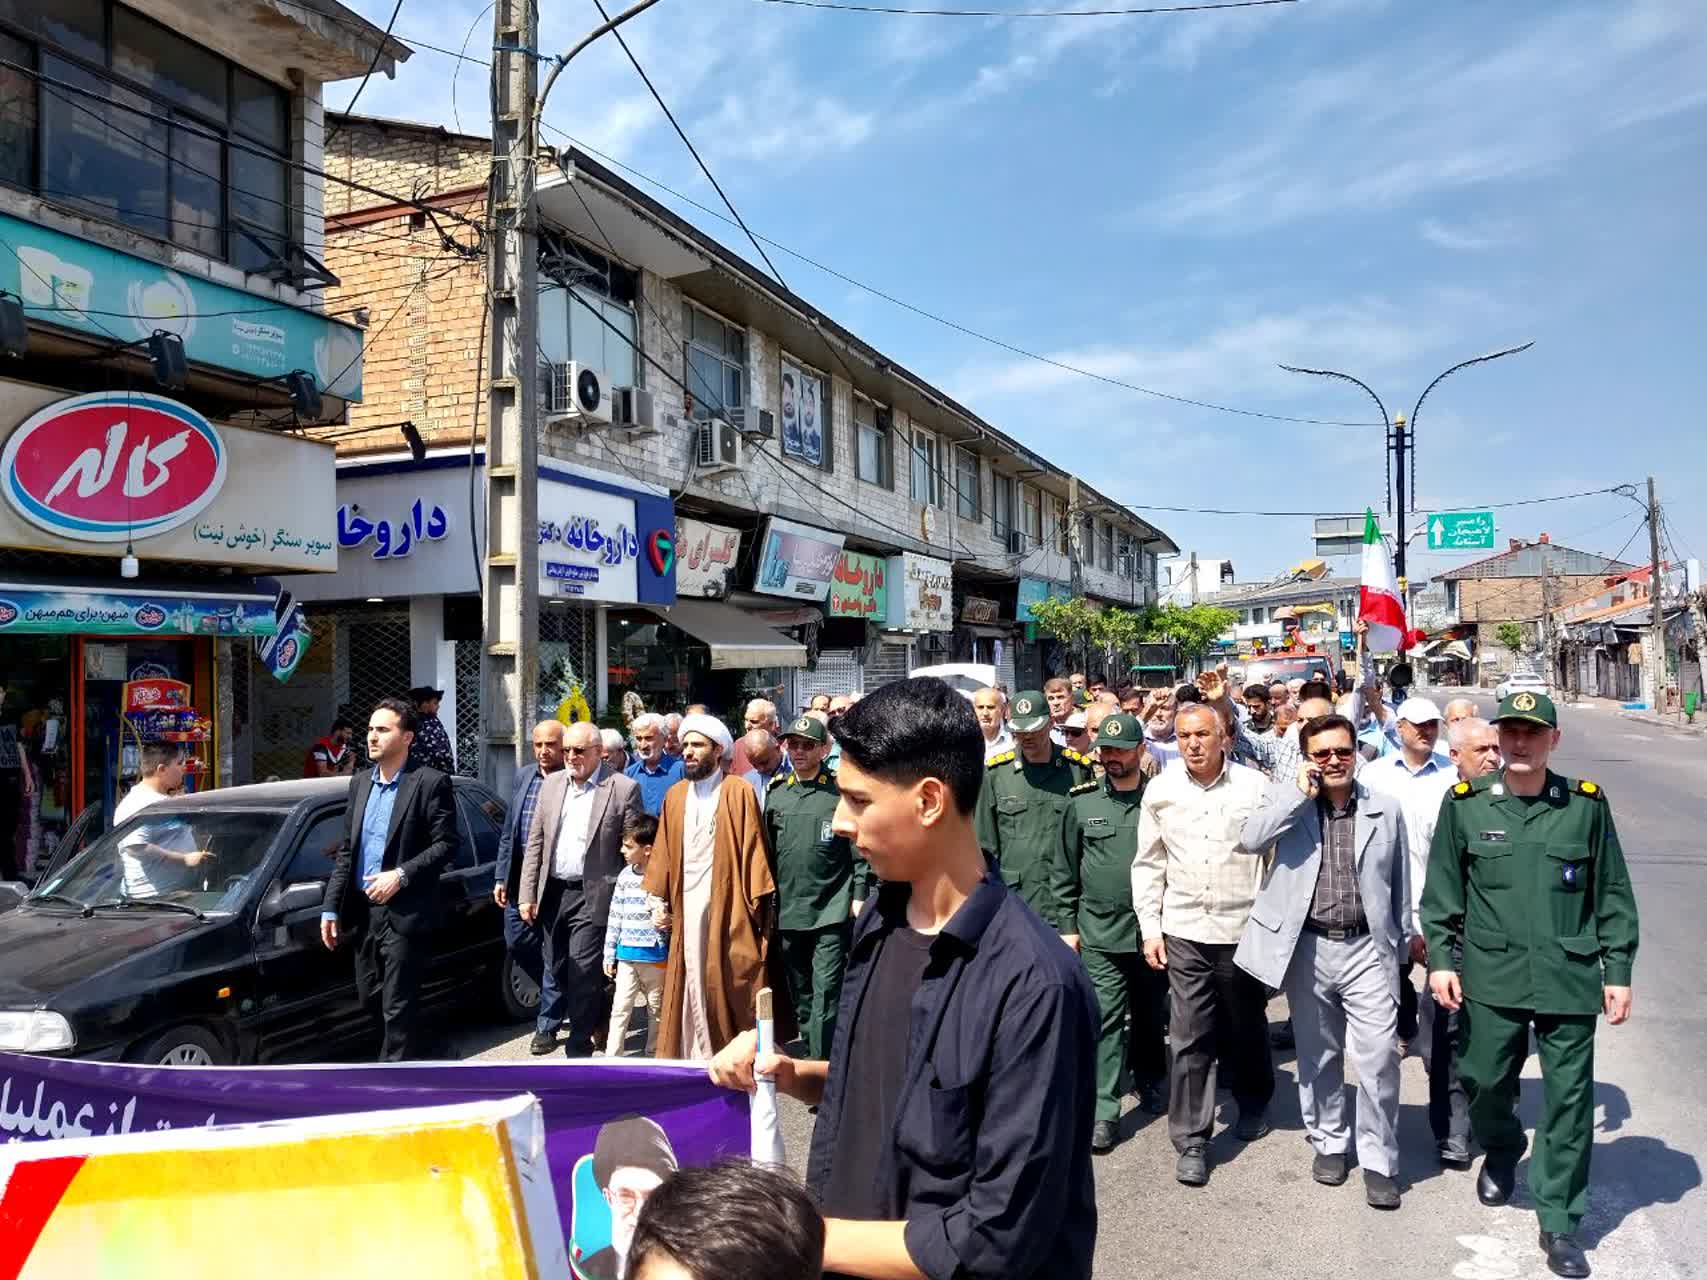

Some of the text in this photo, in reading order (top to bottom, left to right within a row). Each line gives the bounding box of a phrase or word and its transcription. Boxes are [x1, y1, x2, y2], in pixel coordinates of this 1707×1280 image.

[43, 421, 193, 505] کاله
[270, 528, 302, 551] سنگر
[304, 541, 332, 556] سوپر
[337, 498, 447, 559] داروخا
[567, 516, 639, 565] داروخانه
[1447, 526, 1491, 537] لاهیجان
[833, 553, 884, 596] داروخانه
[0, 1077, 95, 1143] عملیا
